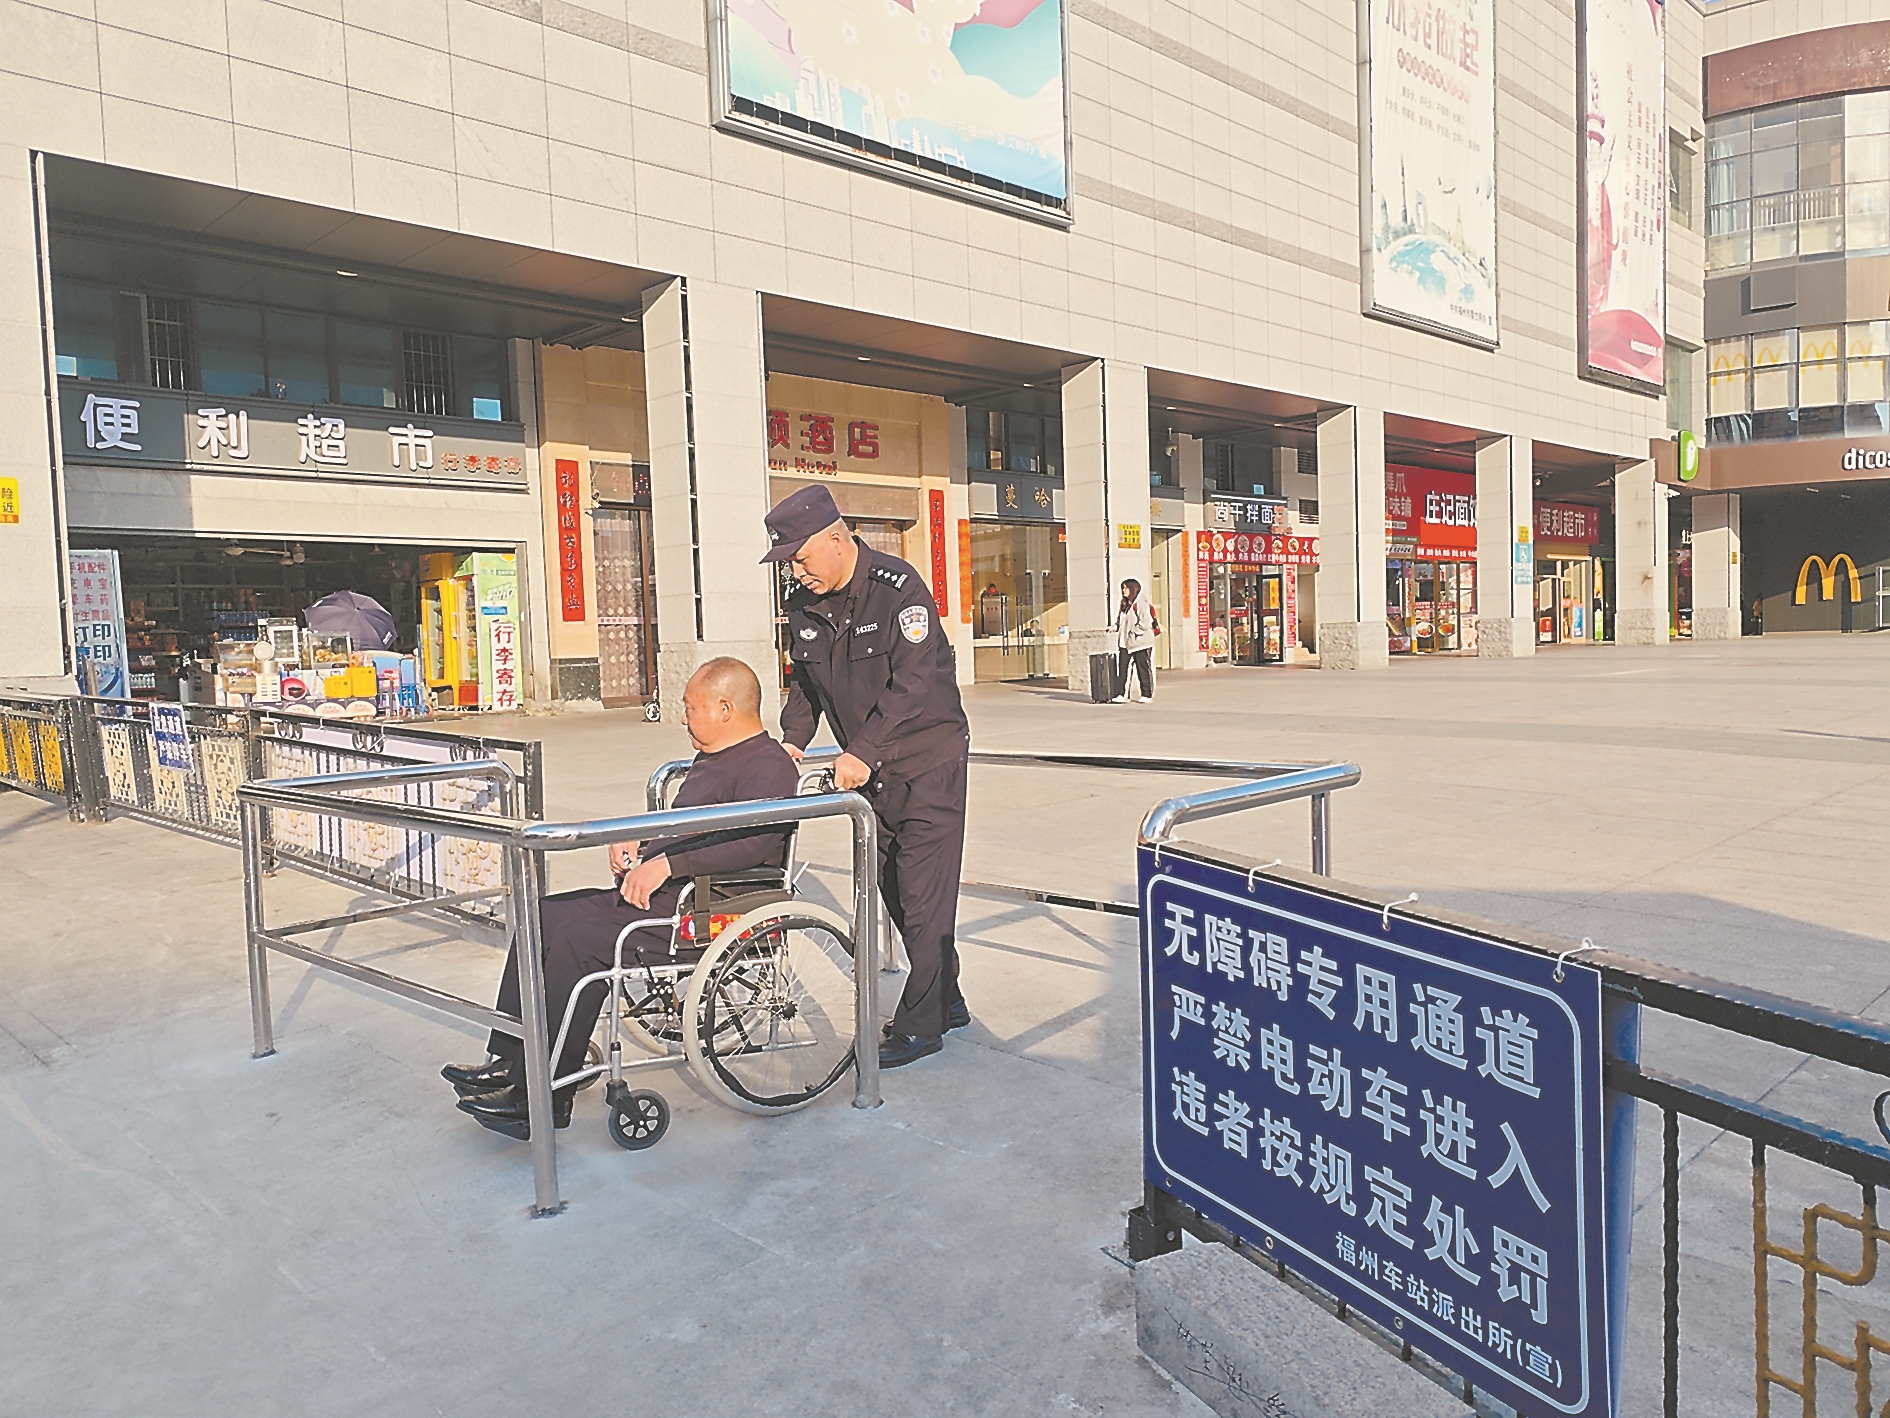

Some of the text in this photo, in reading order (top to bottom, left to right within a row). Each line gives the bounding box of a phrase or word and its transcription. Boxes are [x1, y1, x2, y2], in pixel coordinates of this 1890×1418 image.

[80, 393, 434, 471] 便利超市
[1540, 507, 1585, 538] 便利超市
[494, 624, 516, 708] 行李寄存
[1164, 901, 1542, 1099] 无障碍专用通道
[1170, 984, 1552, 1214] 严禁电动车进入
[1171, 1066, 1549, 1325] 违者按规定处罚
[1336, 1231, 1563, 1389] 福州车站派出所(宣)
